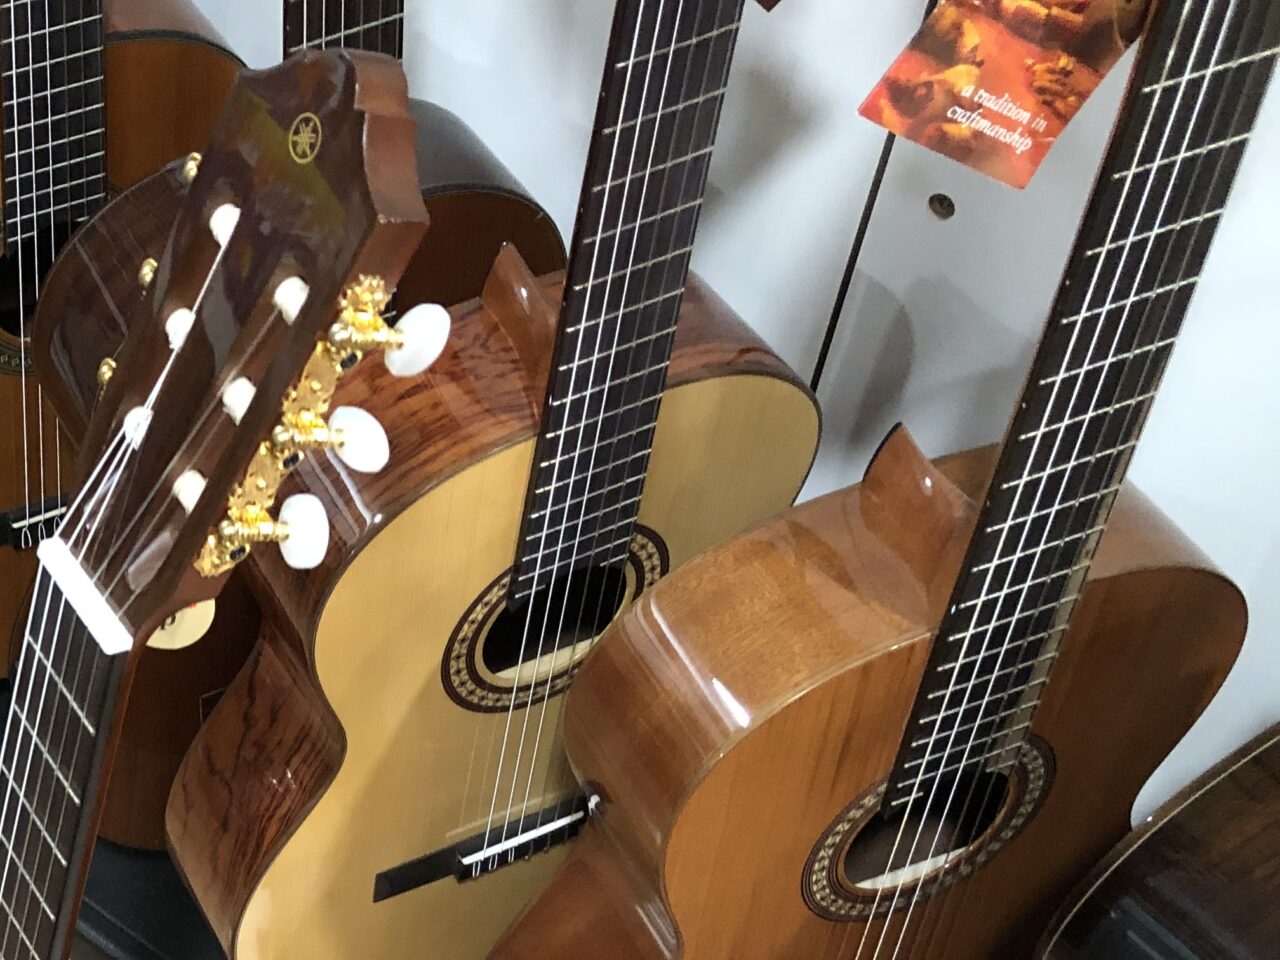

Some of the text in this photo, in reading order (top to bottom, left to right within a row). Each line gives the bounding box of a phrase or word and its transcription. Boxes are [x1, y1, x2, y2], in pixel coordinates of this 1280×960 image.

[960, 85, 1048, 133] a tradition in
